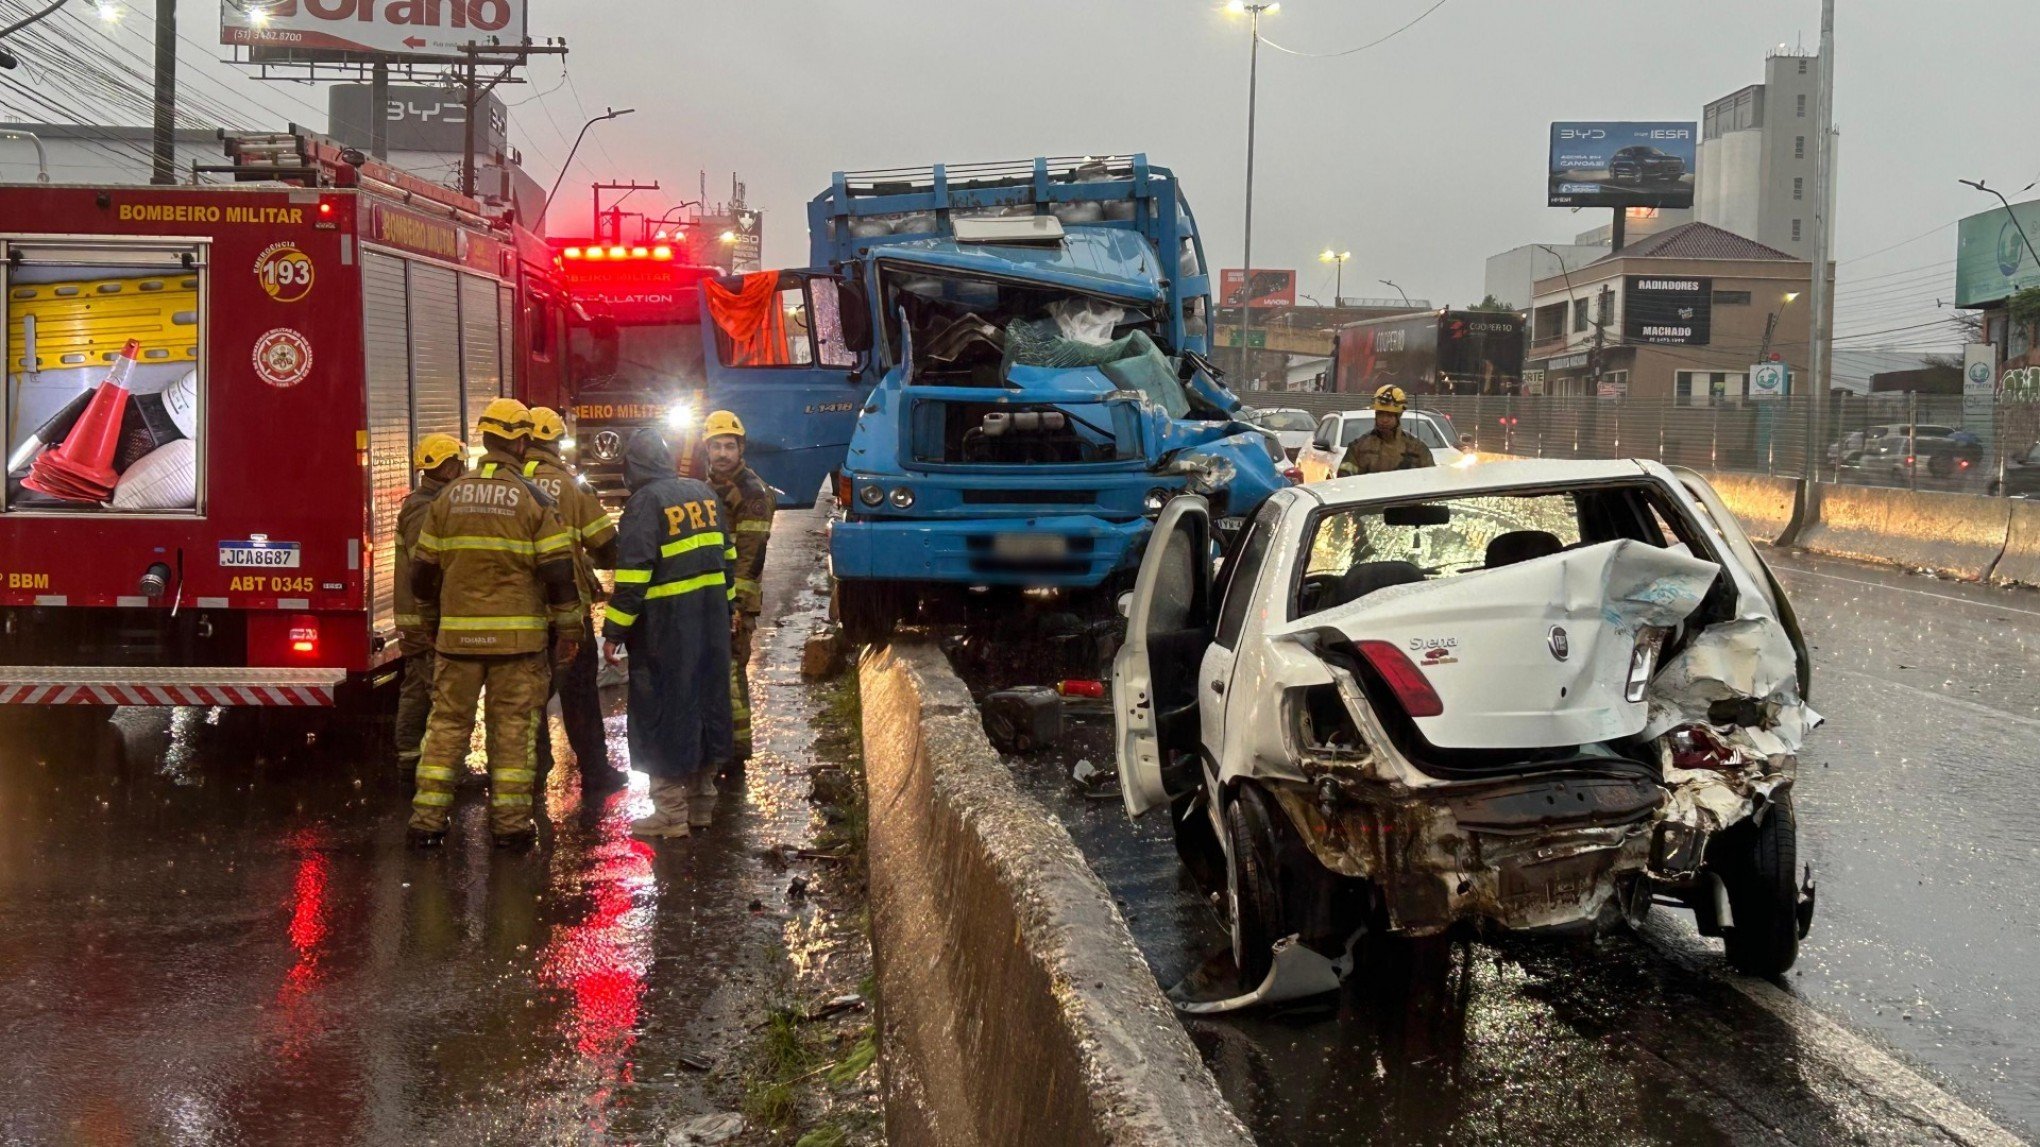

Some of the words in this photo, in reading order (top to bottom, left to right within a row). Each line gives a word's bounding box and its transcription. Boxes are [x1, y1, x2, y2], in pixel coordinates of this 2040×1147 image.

[1560, 129, 1605, 139] BYD
[1650, 129, 1689, 139] IESA
[119, 204, 220, 222] BOMBEIRO
[226, 206, 303, 223] MILITAR
[263, 260, 310, 285] 193
[1638, 280, 1699, 291] RADIADORES
[1642, 326, 1692, 337] MACHADO
[449, 483, 520, 507] CBMRS
[664, 499, 718, 536] PRF
[226, 549, 292, 565] JCA8G87
[9, 572, 49, 589] BBM
[230, 576, 267, 591] ABT
[270, 577, 314, 592] 0345
[1409, 637, 1458, 651] Siena
